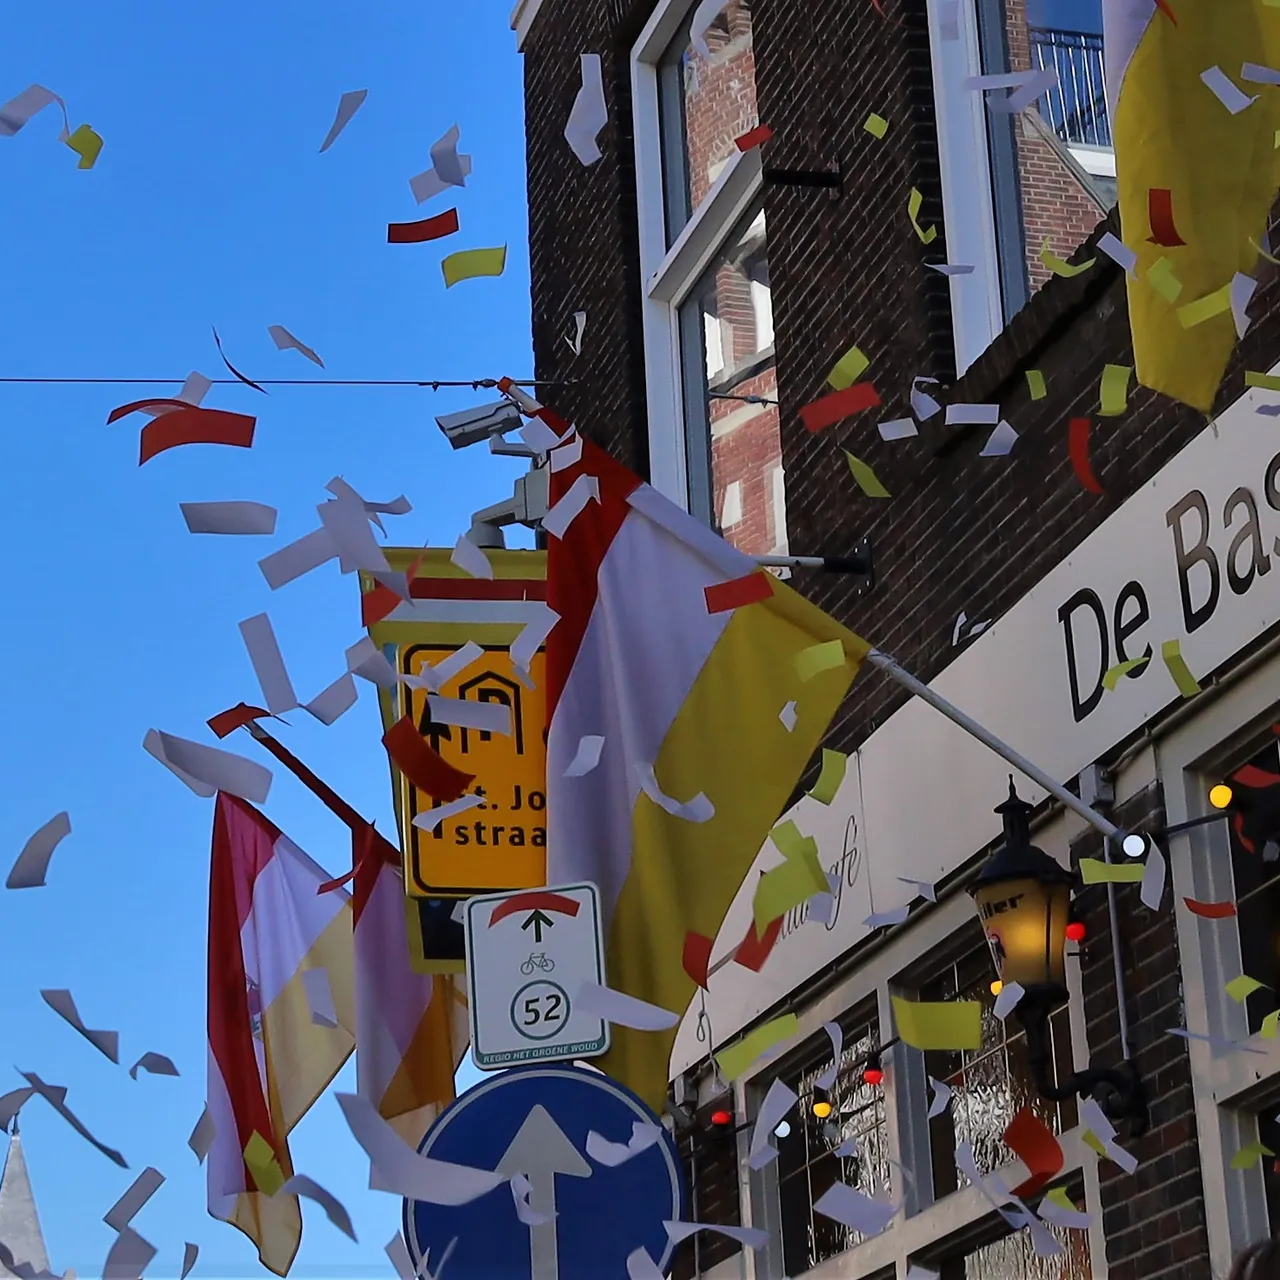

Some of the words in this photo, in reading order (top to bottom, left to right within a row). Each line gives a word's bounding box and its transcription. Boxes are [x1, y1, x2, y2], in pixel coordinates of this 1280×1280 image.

[1057, 581, 1153, 723] De
[457, 785, 499, 810] t.
[510, 785, 546, 811] Jo
[455, 821, 546, 847] straa
[523, 993, 562, 1026] 52
[483, 1052, 511, 1064] REGIO
[513, 1049, 530, 1060] HET
[532, 1045, 569, 1057] GROENE
[571, 1042, 598, 1053] WOUD
